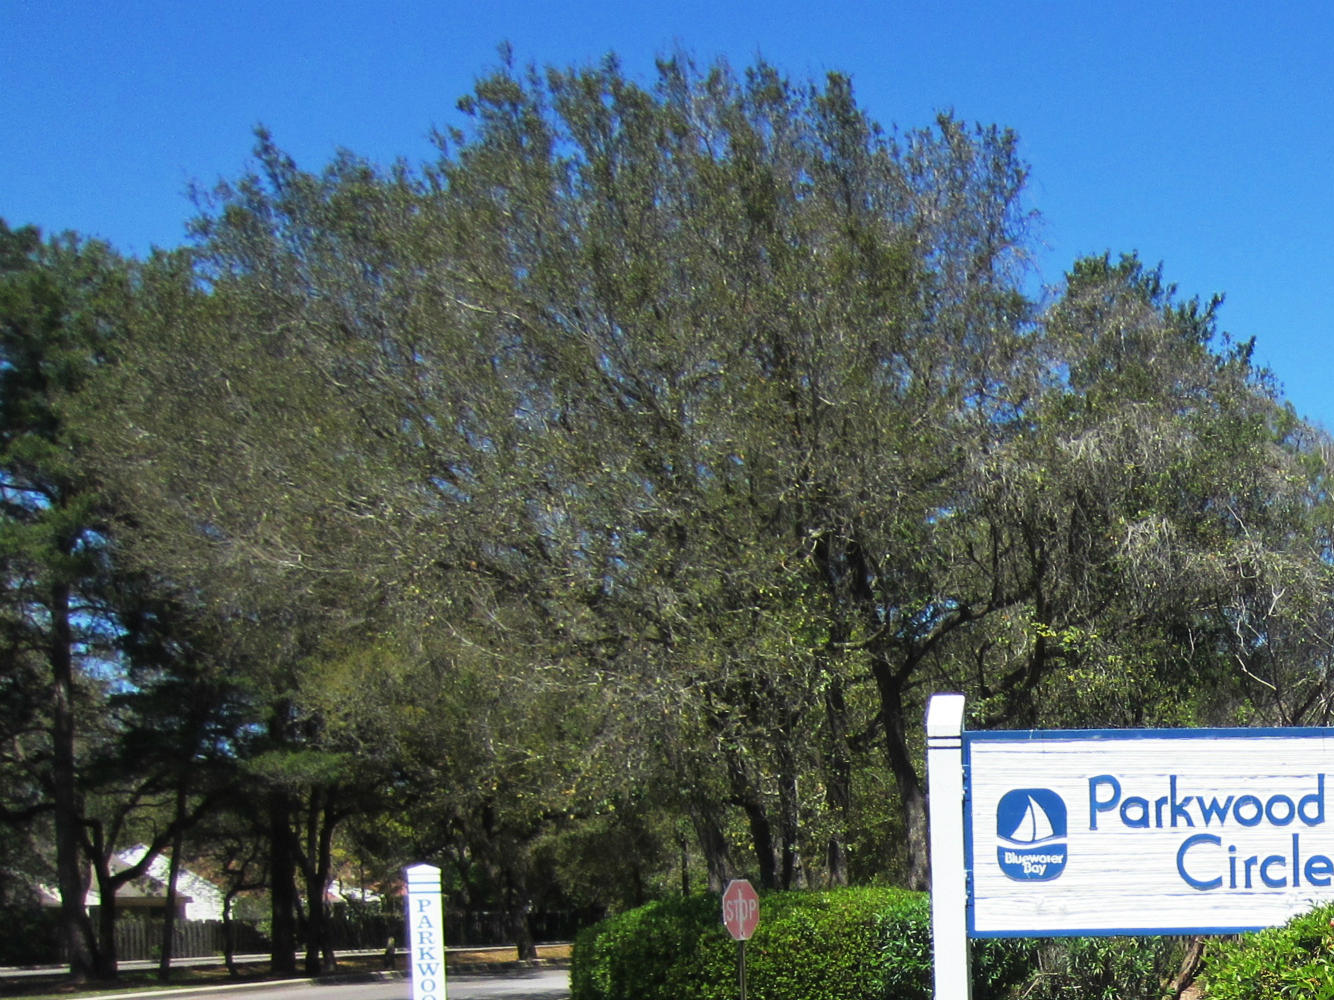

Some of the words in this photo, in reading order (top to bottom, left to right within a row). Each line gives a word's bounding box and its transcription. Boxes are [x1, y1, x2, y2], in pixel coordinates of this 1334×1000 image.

[1088, 773, 1325, 831] Parkwood
[1004, 851, 1064, 865] Bluewater
[1022, 862, 1047, 876] Bay
[1176, 833, 1334, 891] Circle
[726, 898, 757, 922] STOP
